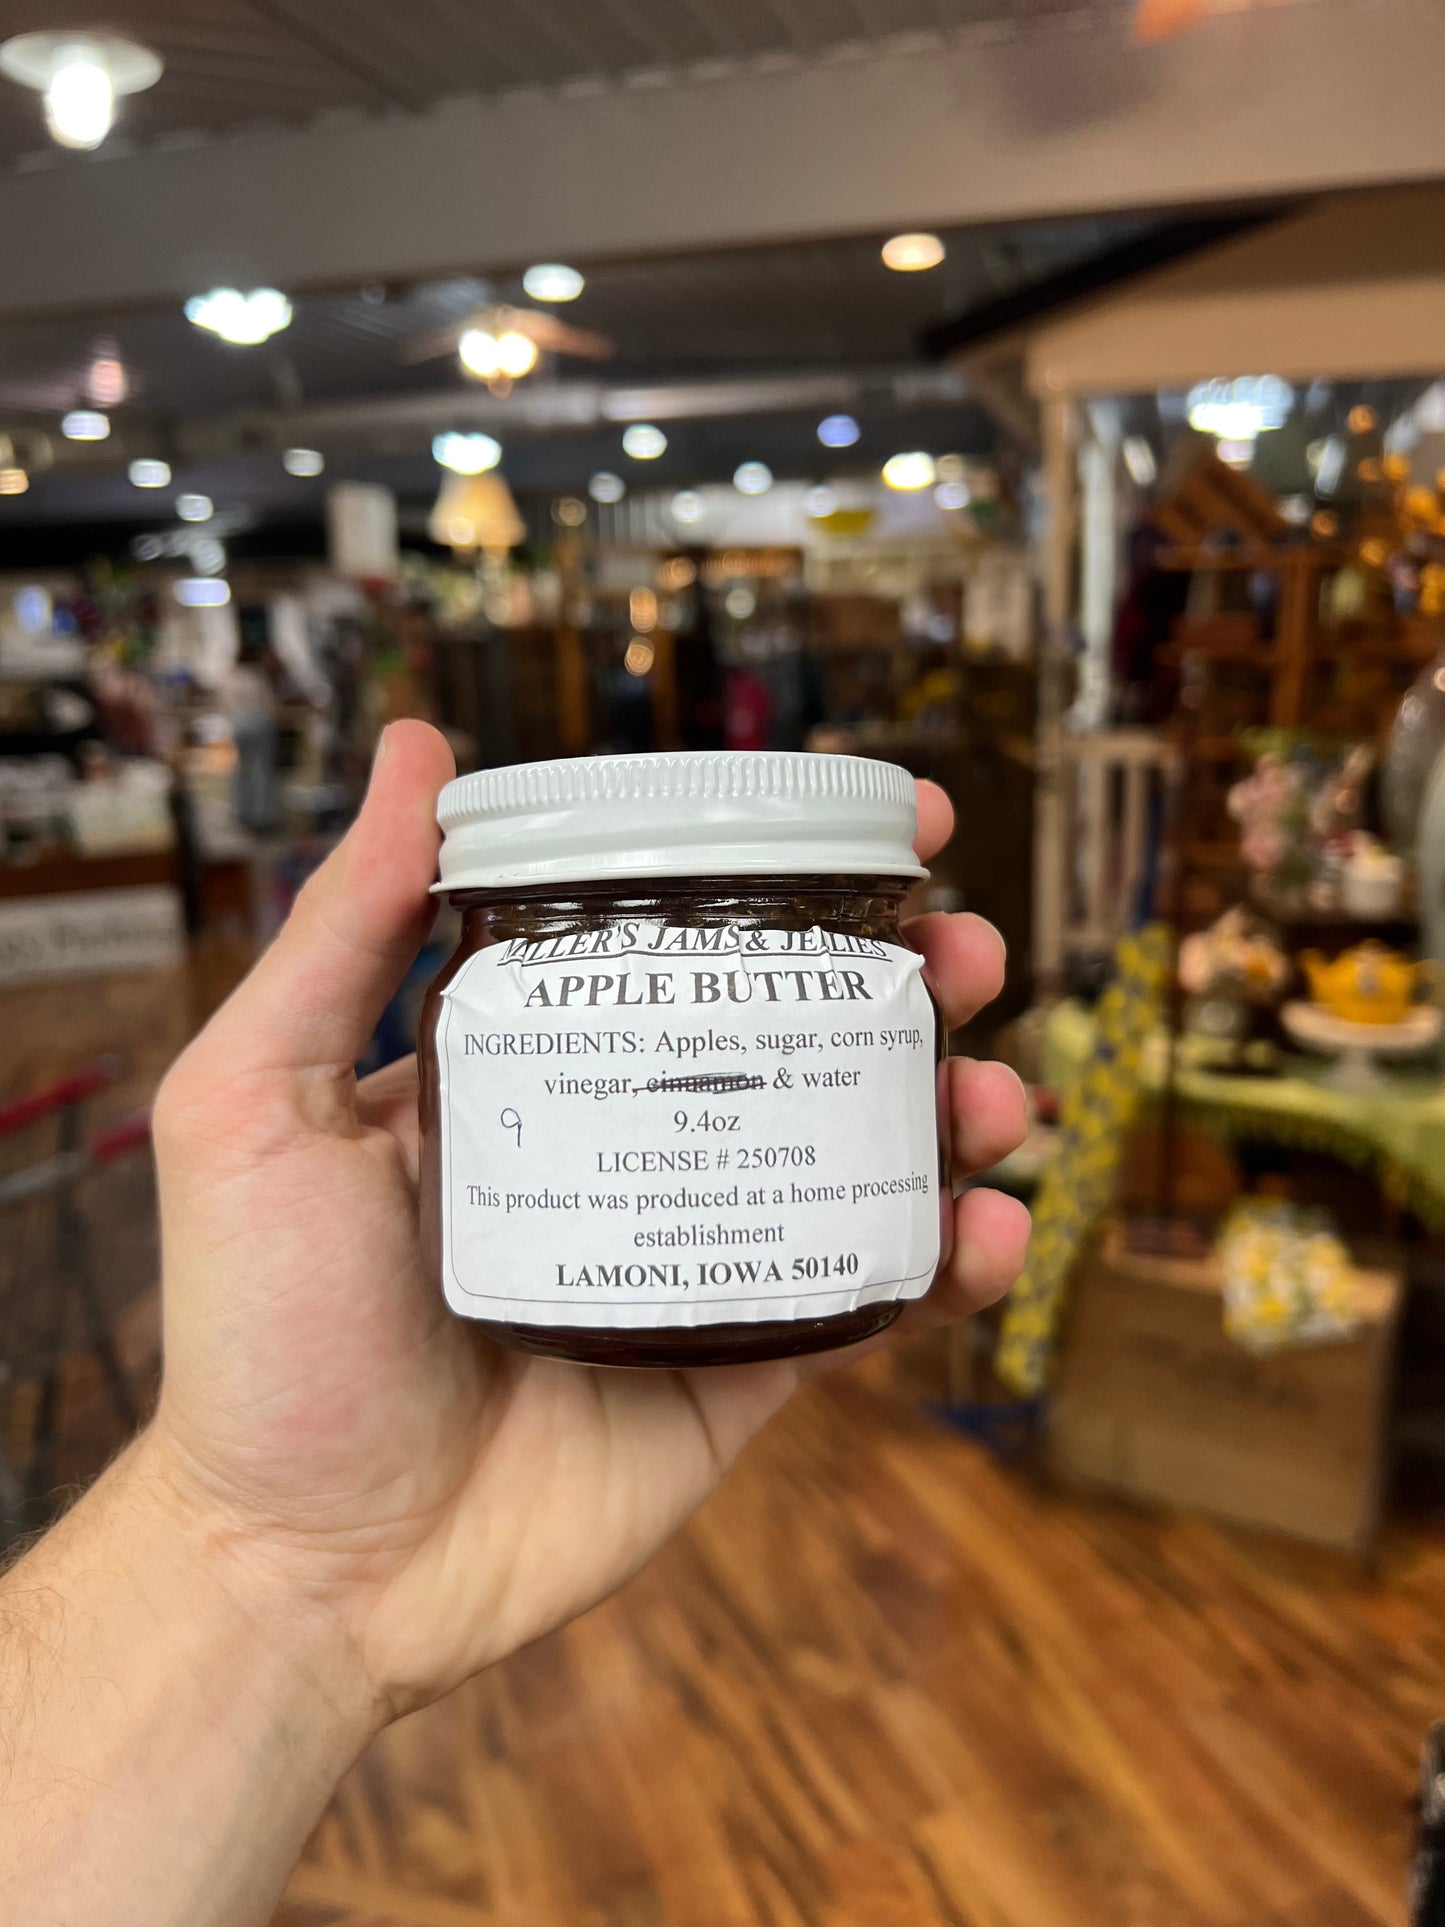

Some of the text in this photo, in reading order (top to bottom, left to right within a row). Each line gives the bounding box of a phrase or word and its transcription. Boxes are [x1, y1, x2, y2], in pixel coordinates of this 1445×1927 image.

[648, 924, 740, 951] JAMS
[745, 929, 769, 951] &
[523, 965, 874, 1009] APPLE BUTTER
[464, 1028, 923, 1057] INGREDIENTS: Apples, sugar, corn syrup,
[543, 1071, 641, 1101] vinegar,
[772, 1066, 795, 1090] &
[801, 1067, 862, 1089] water
[673, 1109, 741, 1134] 9.4oz
[597, 1144, 816, 1173] LICENSE # 250708
[466, 1170, 929, 1215] This product was produced at a home processing
[633, 1222, 785, 1248] establishment
[555, 1252, 859, 1292] LAMONI, IOWA 50140
